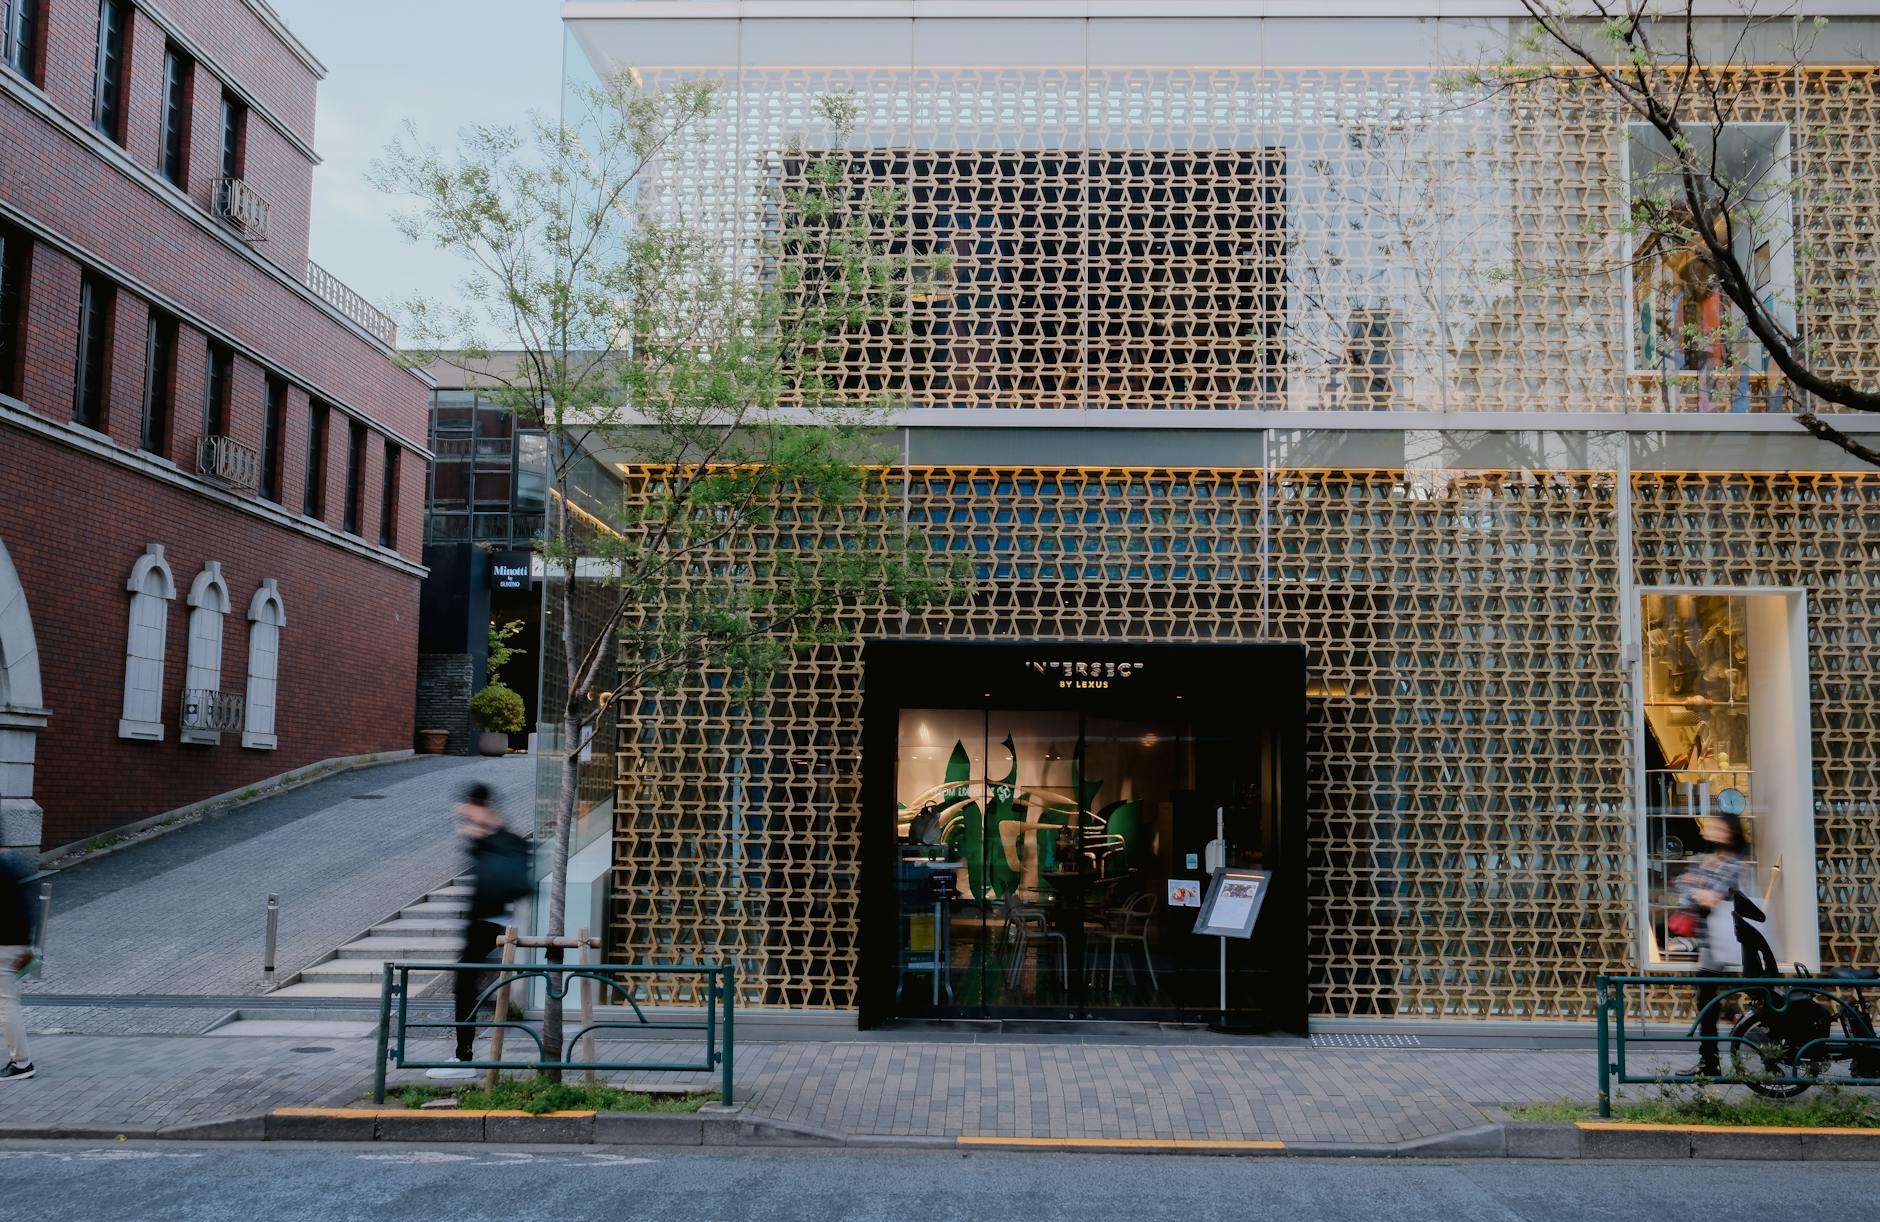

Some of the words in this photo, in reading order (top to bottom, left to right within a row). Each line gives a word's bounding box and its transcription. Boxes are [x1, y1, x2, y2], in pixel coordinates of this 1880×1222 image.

[493, 565, 528, 576] Minotti
[1059, 680, 1072, 689] BY
[1076, 680, 1109, 689] LEXUS
